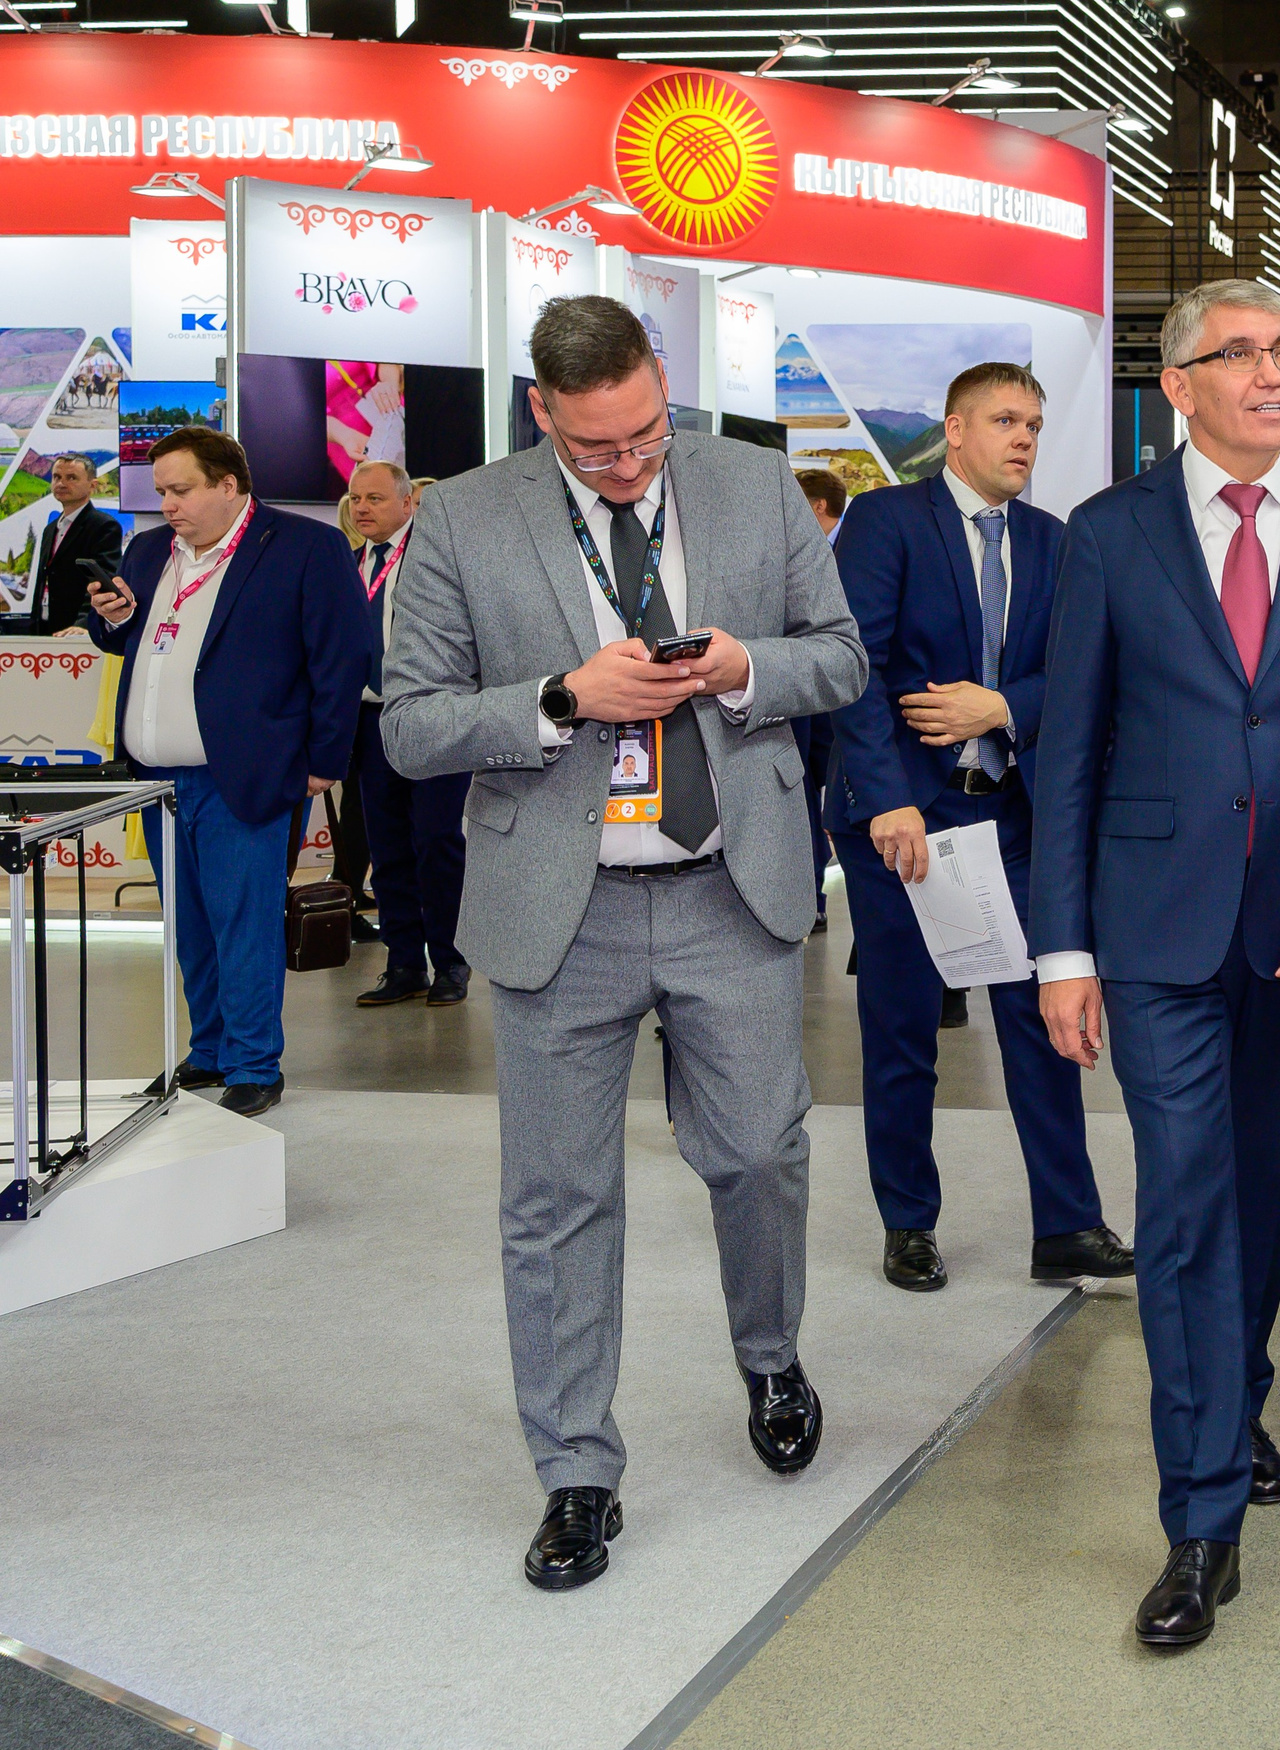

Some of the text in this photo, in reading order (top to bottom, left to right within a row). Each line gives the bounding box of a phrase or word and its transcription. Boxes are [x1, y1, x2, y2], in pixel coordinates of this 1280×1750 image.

[143, 115, 400, 161] РЕСПУБЛИКА
[794, 153, 1088, 240] КЫРГЫЗСКАЯ РЕСПУБЛИКА
[299, 272, 413, 312] BRAVO
[625, 805, 632, 814] 2
